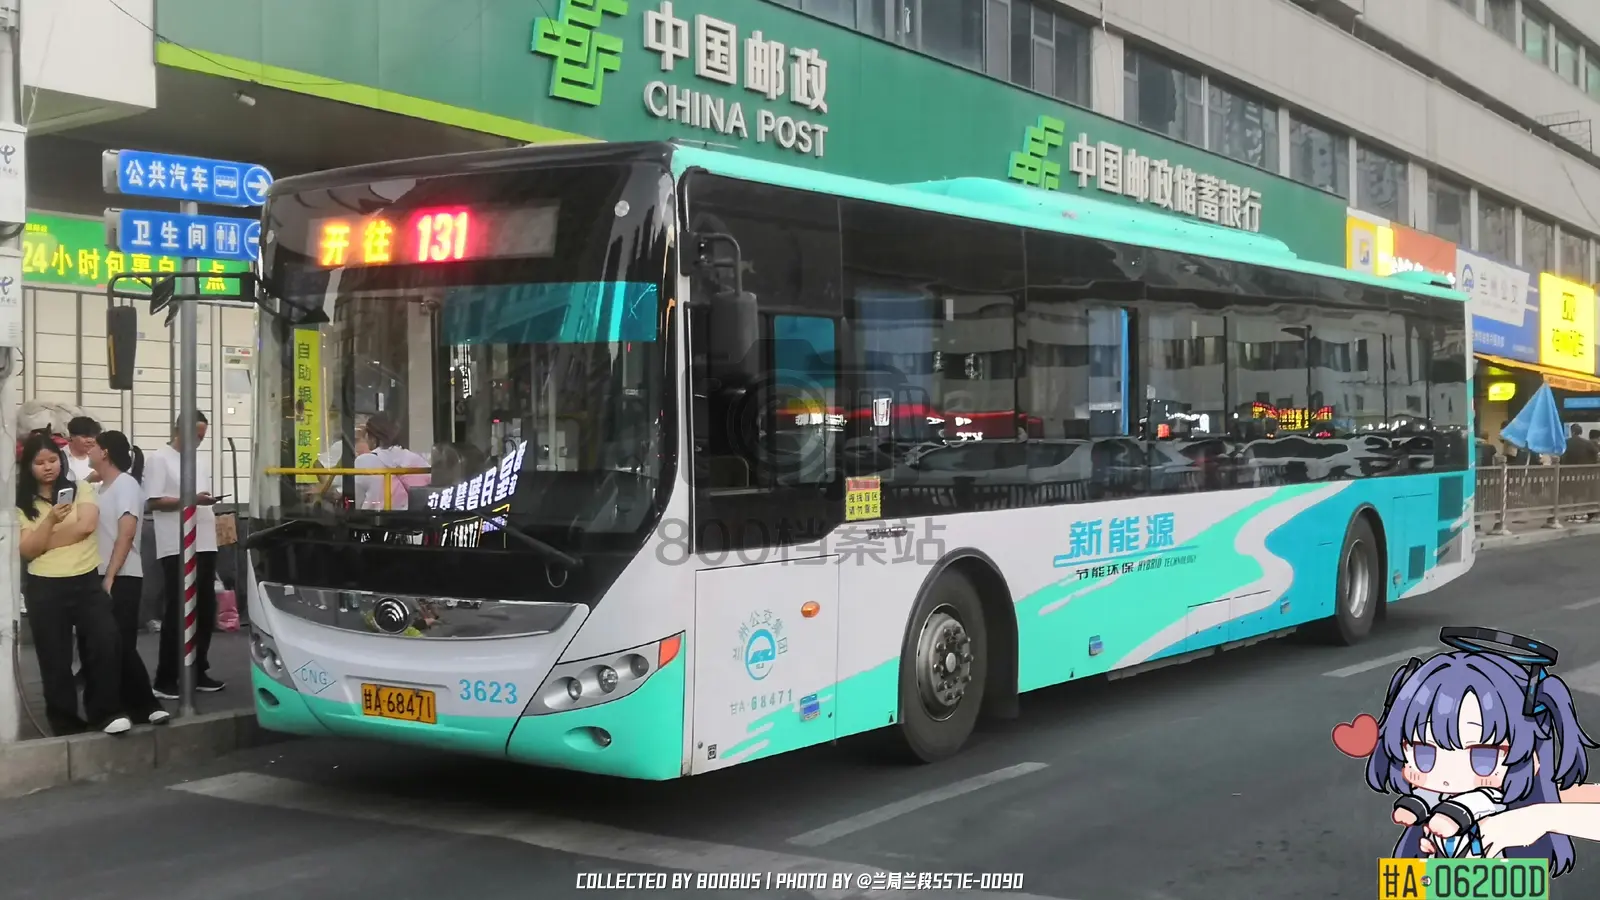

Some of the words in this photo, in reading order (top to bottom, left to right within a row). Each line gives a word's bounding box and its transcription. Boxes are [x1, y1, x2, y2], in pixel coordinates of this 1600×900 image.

[643, 1, 827, 114] 中国邮政
[644, 81, 748, 138] CHINA
[756, 109, 828, 157] POST
[125, 159, 208, 193] 公共汽车
[1069, 132, 1262, 233] 中国邮政储蓄银行
[131, 219, 207, 250] 卫生间
[321, 218, 393, 266] 开往
[416, 211, 469, 262] 131
[1068, 512, 1175, 557] 新能源
[1076, 562, 1134, 580] 节能环保
[1137, 557, 1162, 573] HYBRID
[301, 668, 329, 686] CNG
[459, 679, 518, 704] 3623
